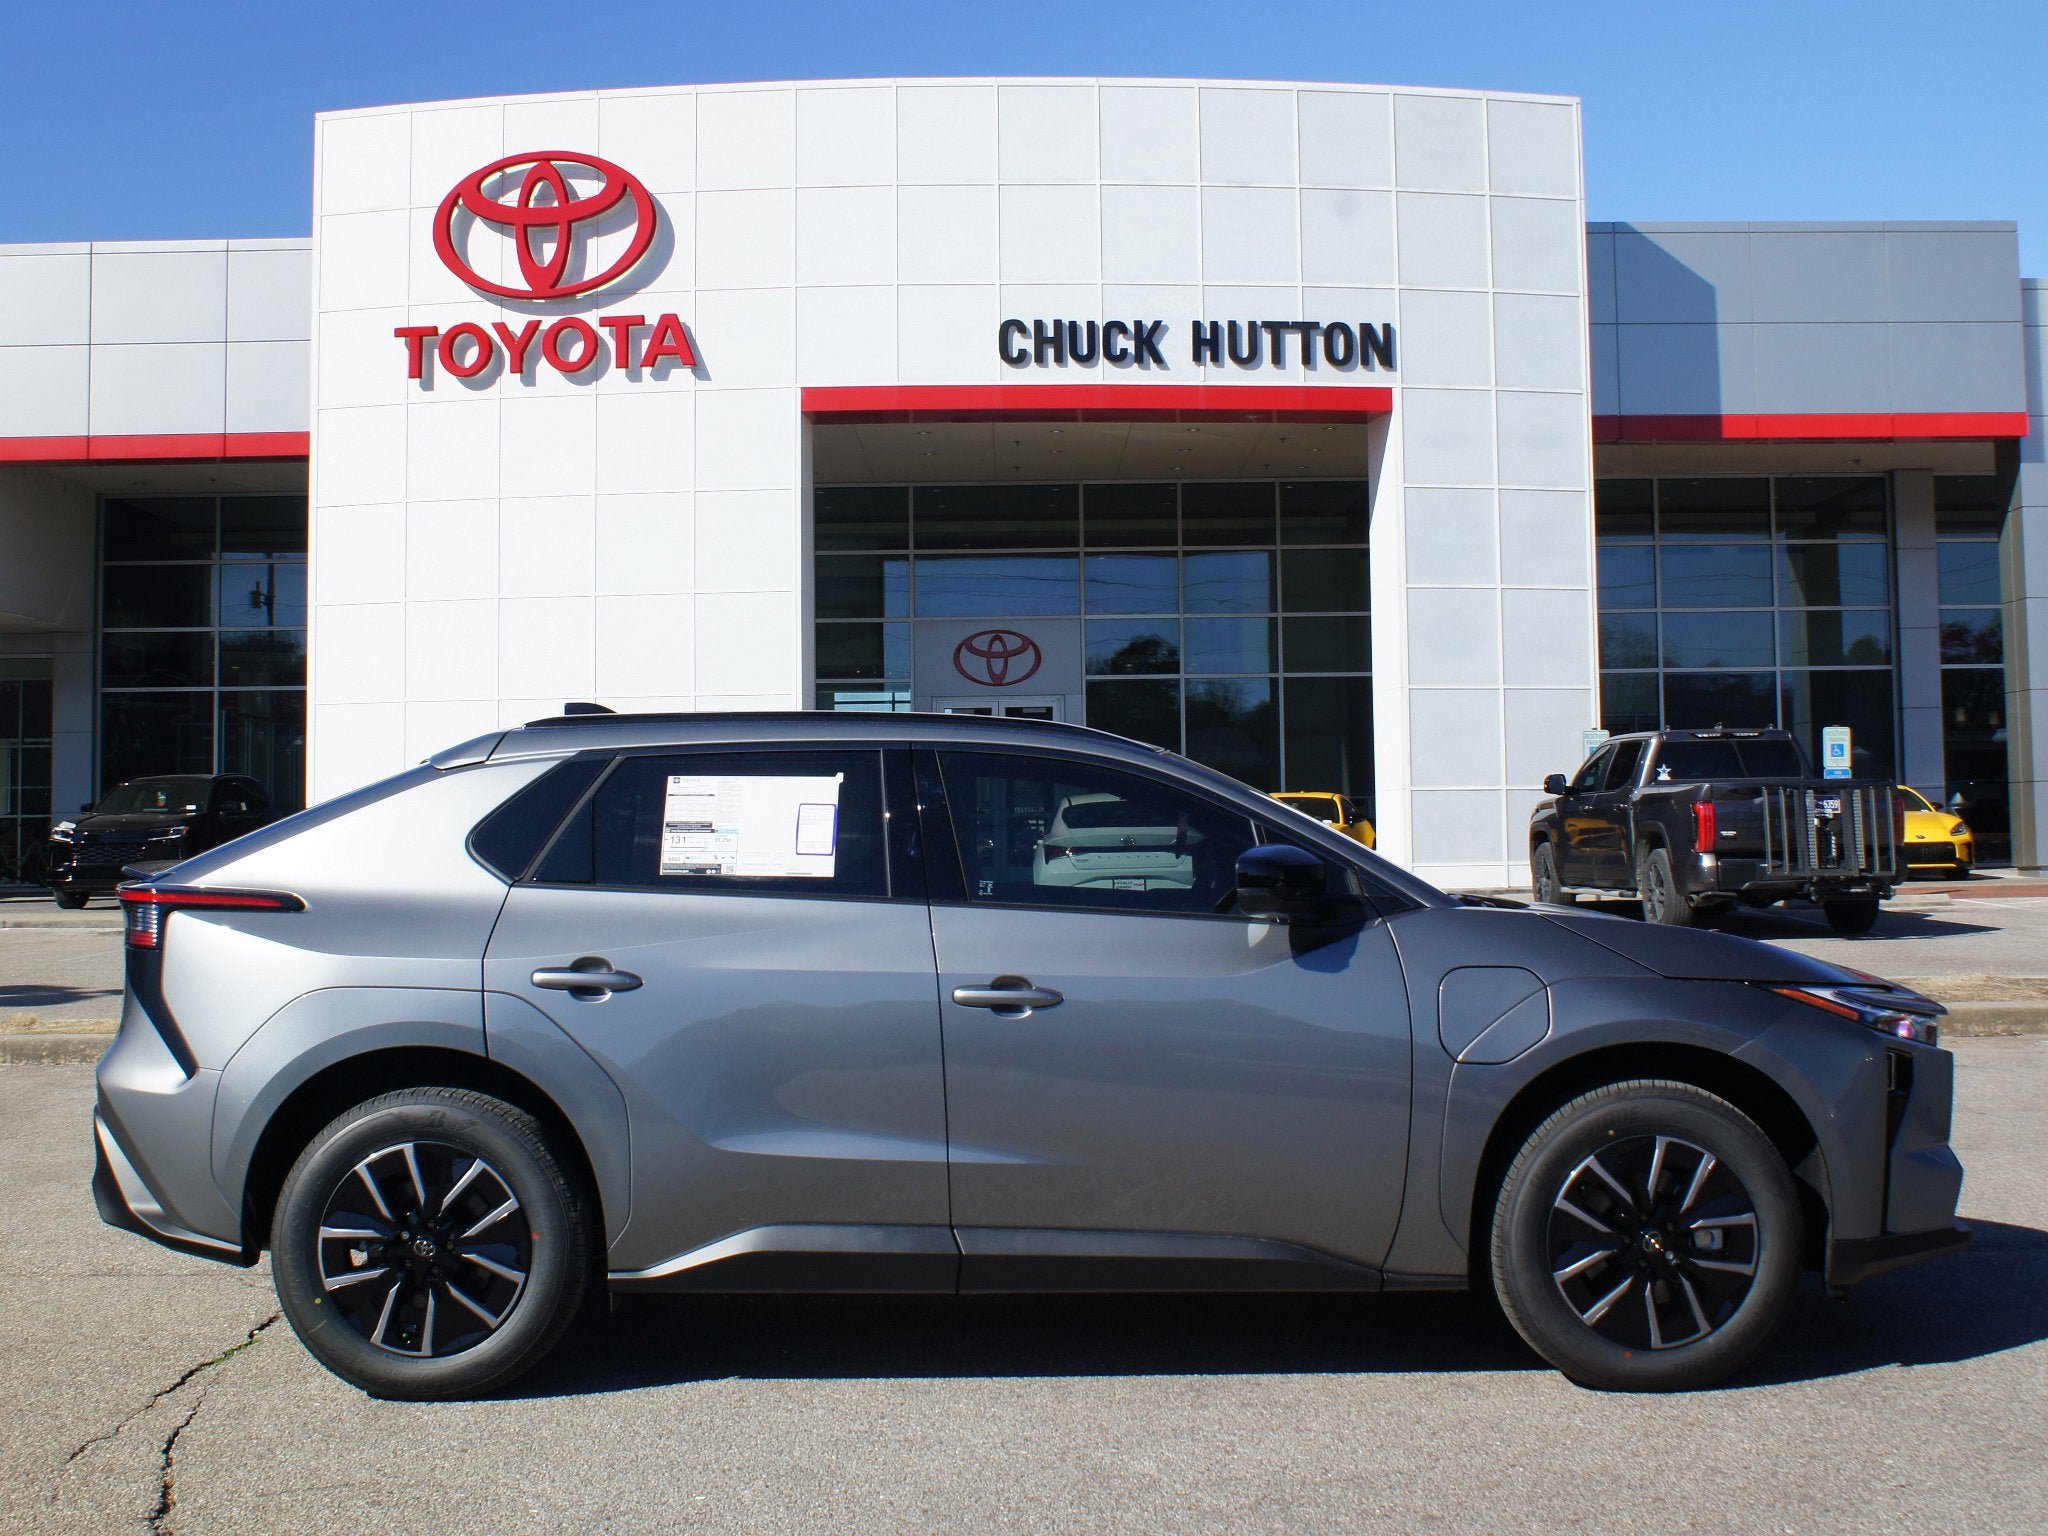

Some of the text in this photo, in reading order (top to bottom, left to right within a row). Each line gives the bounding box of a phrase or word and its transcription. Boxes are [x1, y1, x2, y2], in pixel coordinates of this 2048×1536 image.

[394, 313, 697, 380] TOYOTA
[999, 319, 1393, 368] CHUCK HUTTON
[670, 835, 687, 845] 131
